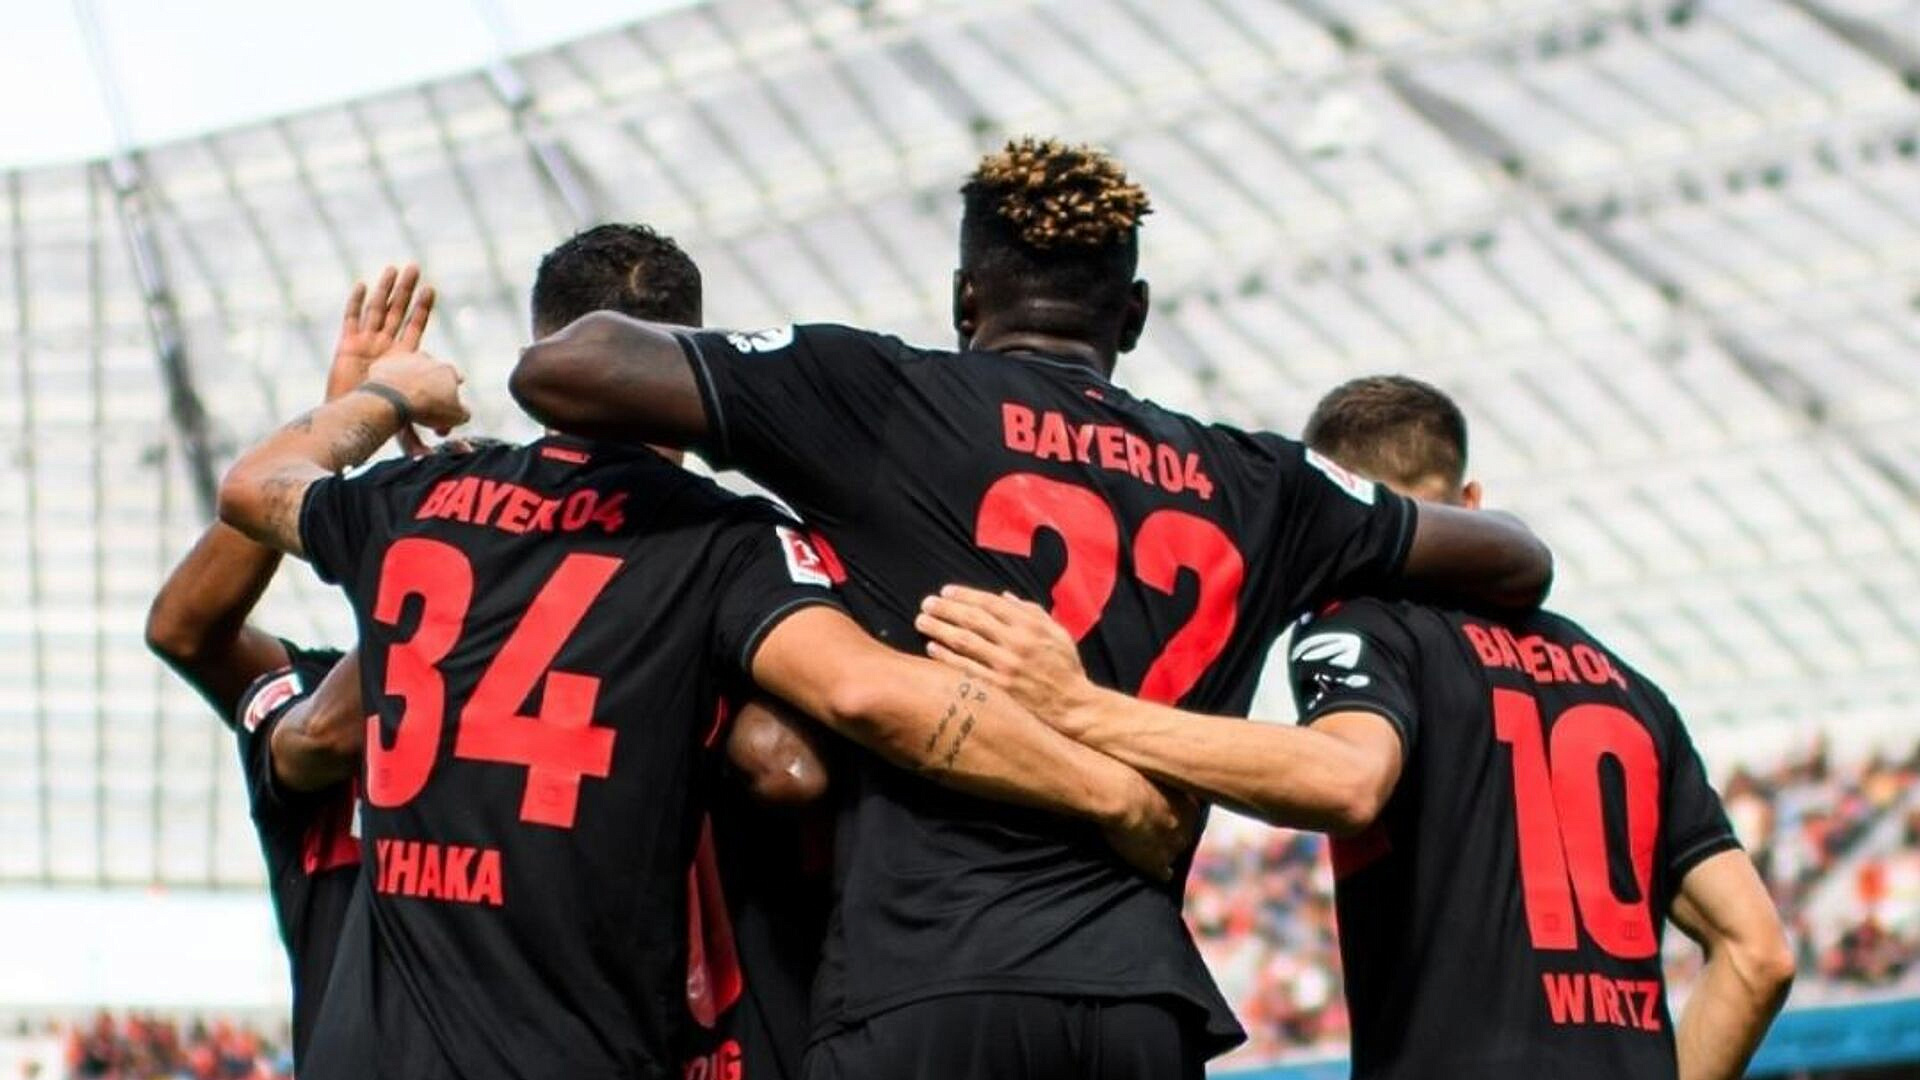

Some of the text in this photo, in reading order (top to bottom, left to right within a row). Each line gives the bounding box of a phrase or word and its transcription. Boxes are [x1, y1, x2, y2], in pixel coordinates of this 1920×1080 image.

[415, 475, 629, 534] BAYER 04
[1002, 403, 1214, 500] BAYER 04
[974, 471, 1245, 707] 22
[364, 536, 622, 829] 34
[1491, 686, 1660, 960] 10
[1542, 972, 1662, 1032] WIRTZ
